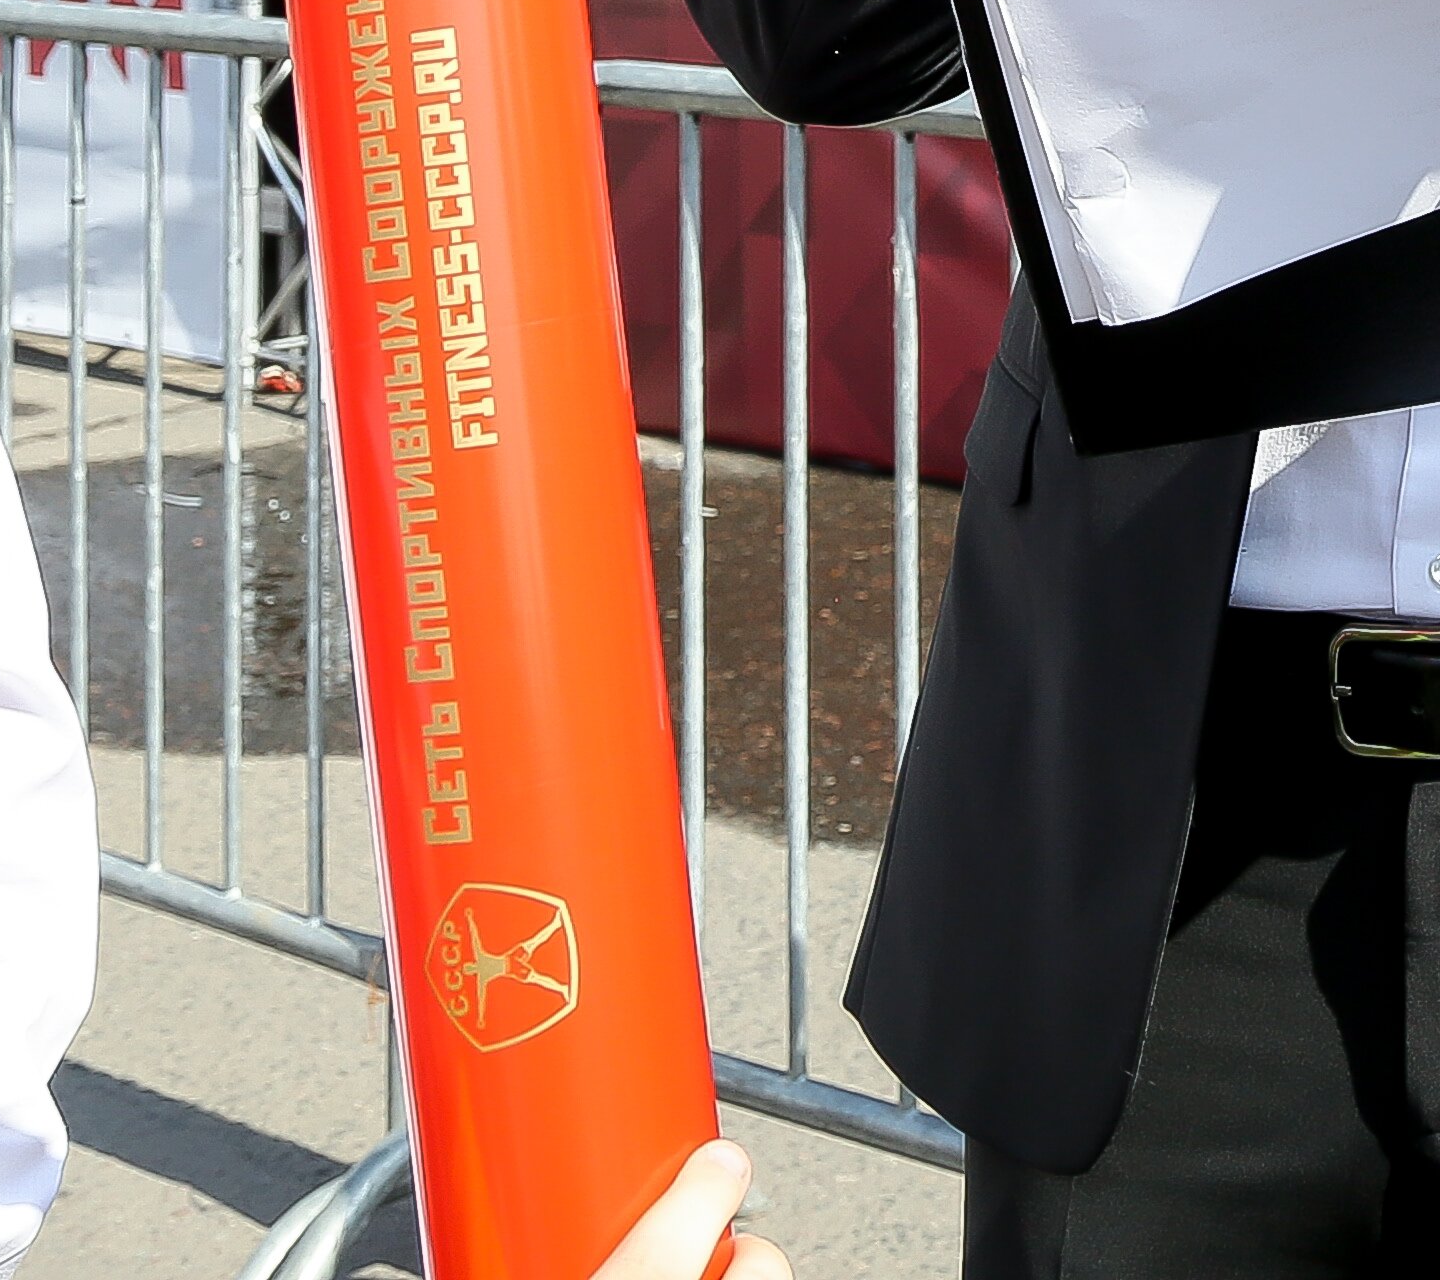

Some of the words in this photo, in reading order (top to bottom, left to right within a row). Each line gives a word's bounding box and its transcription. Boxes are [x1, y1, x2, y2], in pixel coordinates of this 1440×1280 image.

[410, 26, 500, 450] FITNESS-CCCP.RU
[379, 294, 454, 684] СПОРТИВНЫХ
[441, 920, 470, 1017] СССР
